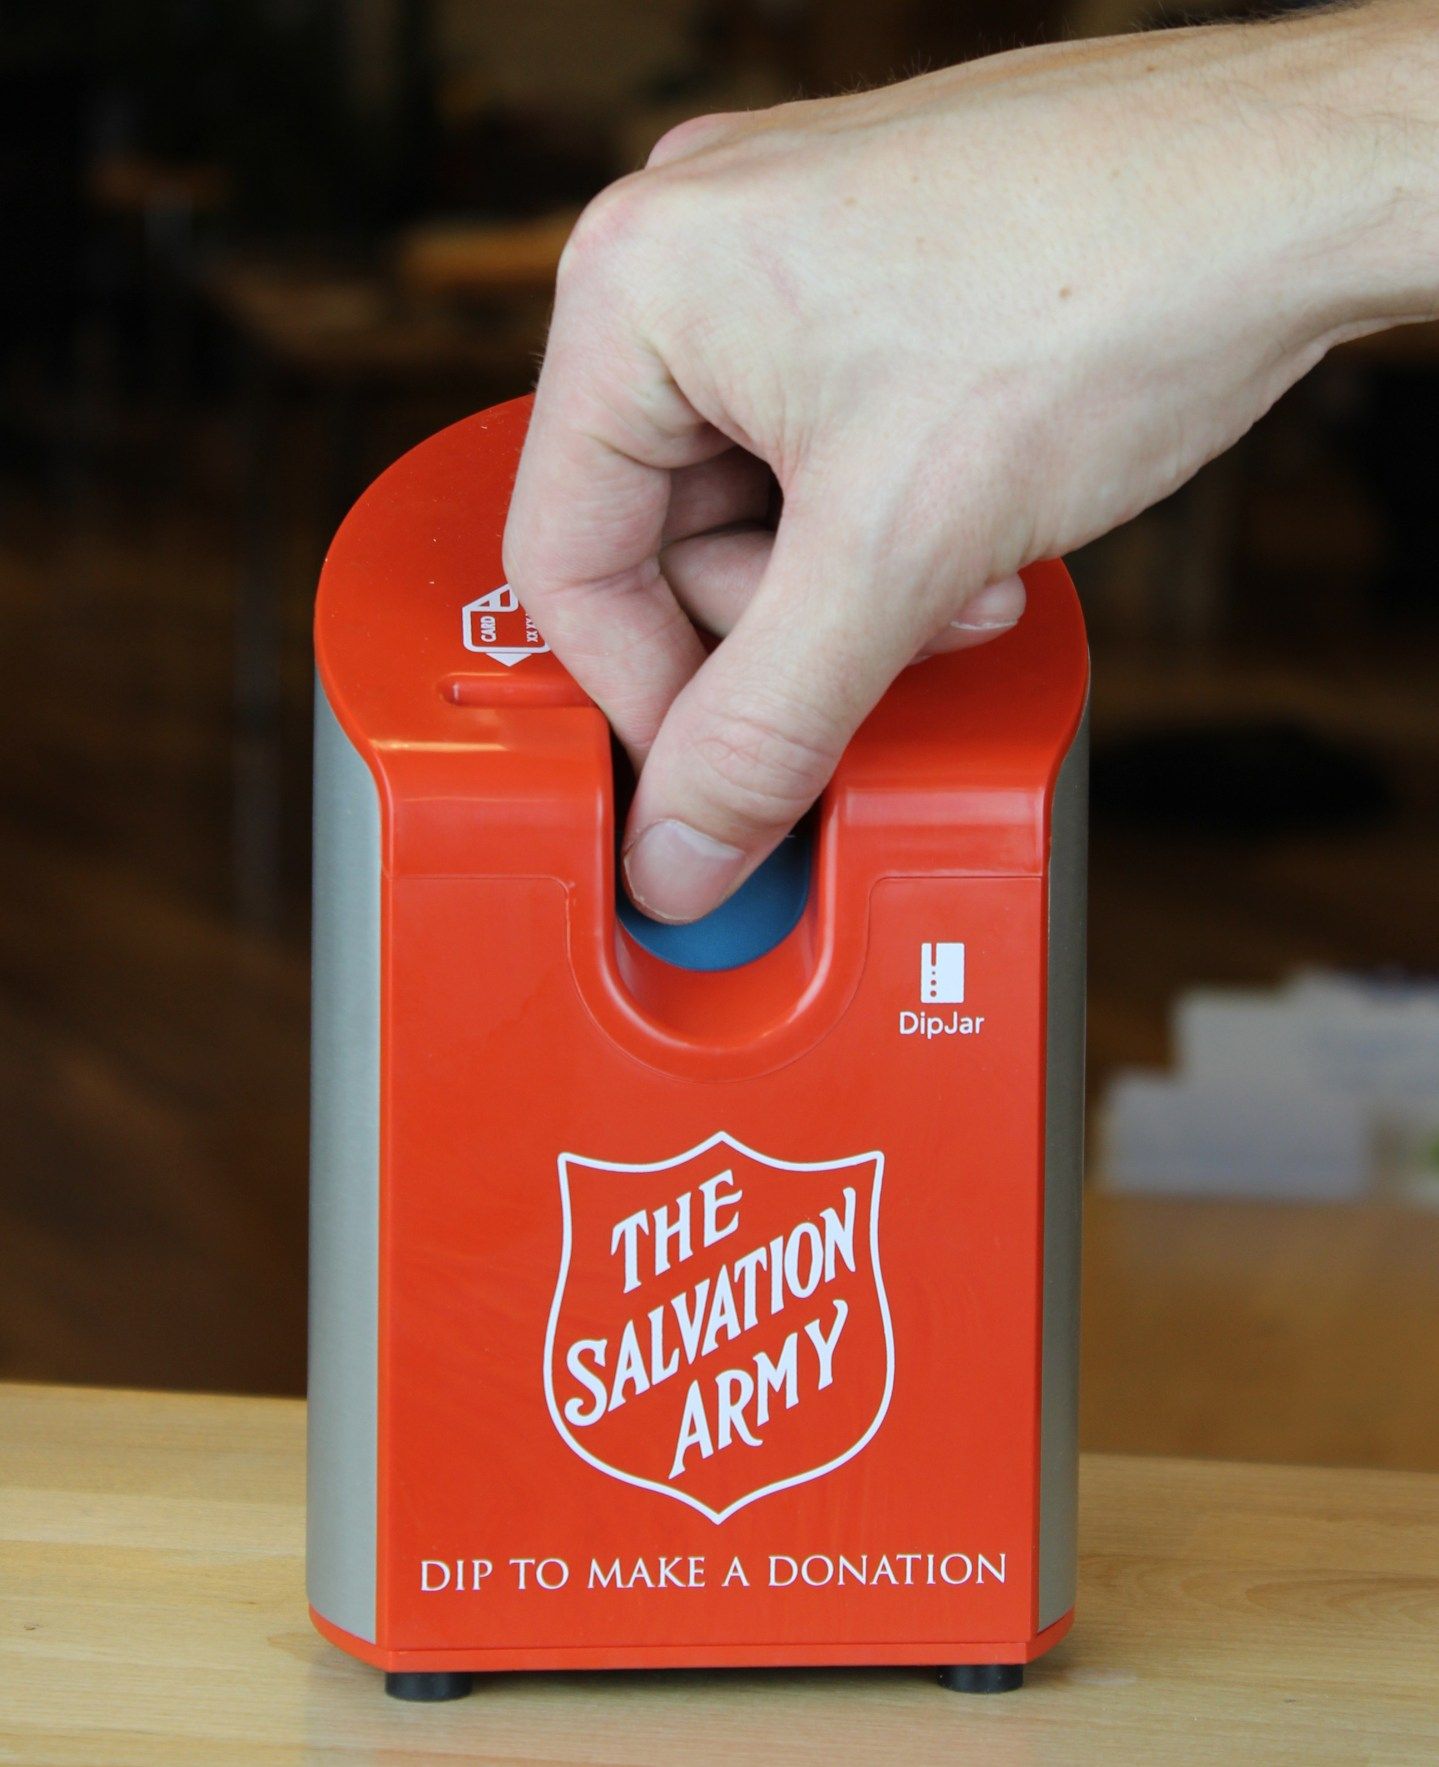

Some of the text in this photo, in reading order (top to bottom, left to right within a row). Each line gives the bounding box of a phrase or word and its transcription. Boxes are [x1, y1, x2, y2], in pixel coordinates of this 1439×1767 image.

[480, 615, 497, 643] CARD
[899, 1010, 985, 1040] DipJar
[610, 1168, 743, 1294] THE
[564, 1186, 857, 1427] SALVATION
[668, 1299, 849, 1480] ARMY
[420, 1552, 1007, 1592] DIP TO MAKE A DONATION
